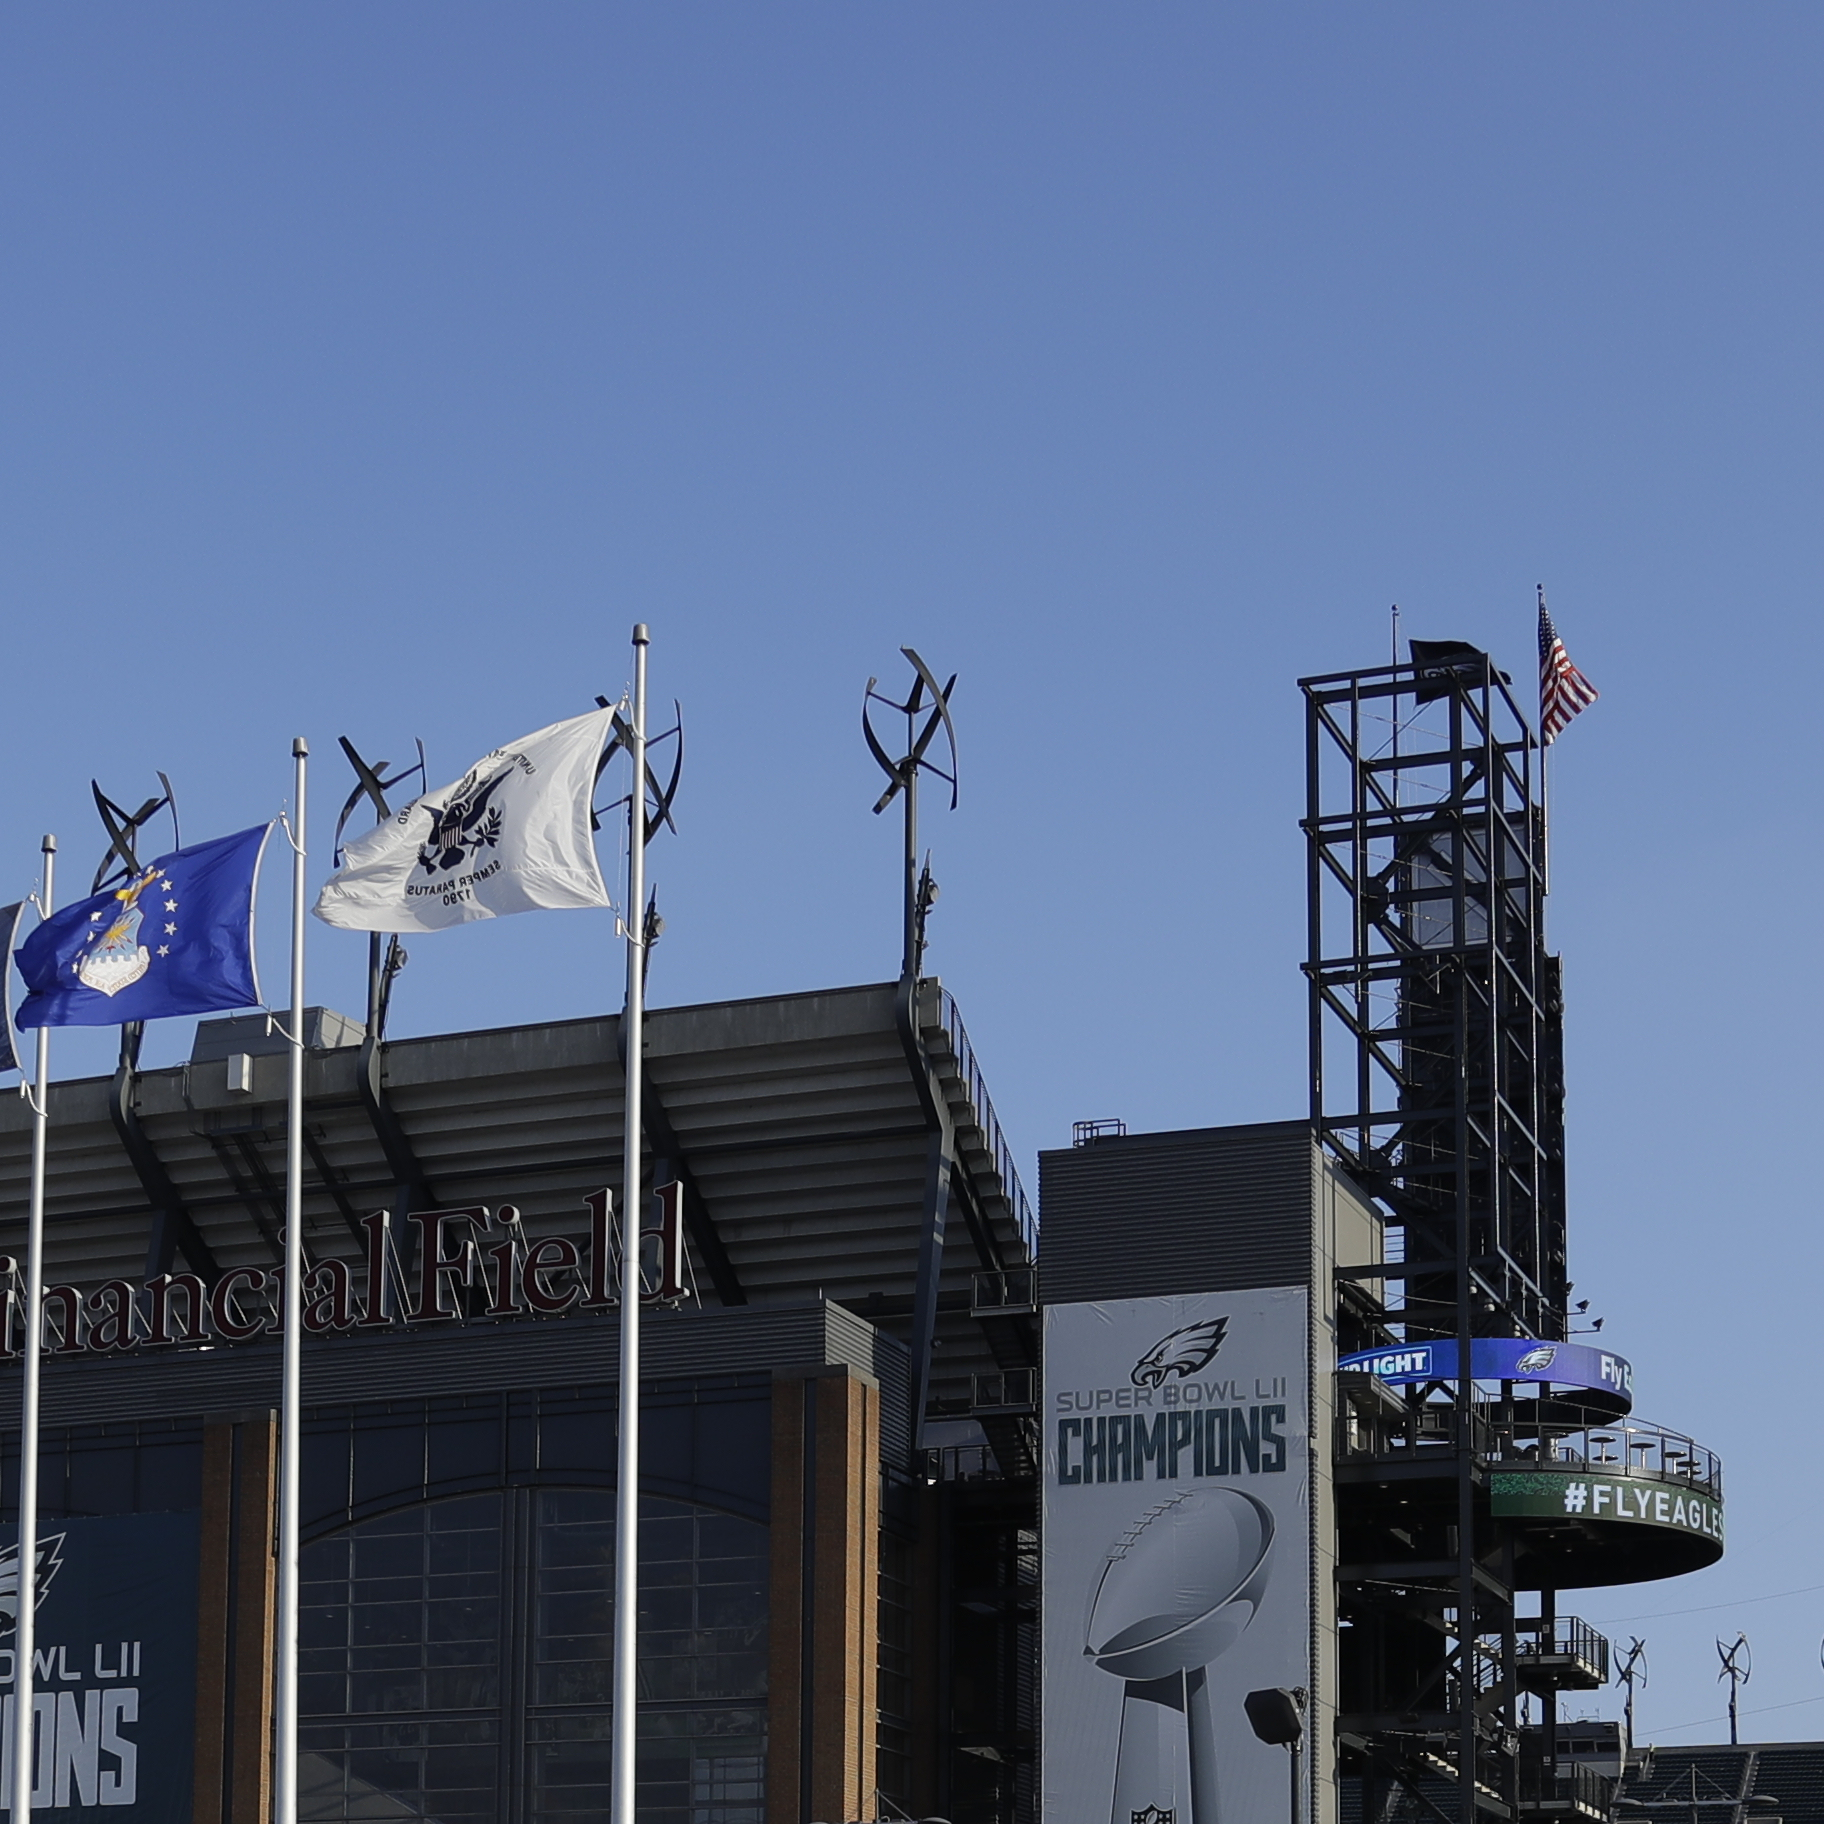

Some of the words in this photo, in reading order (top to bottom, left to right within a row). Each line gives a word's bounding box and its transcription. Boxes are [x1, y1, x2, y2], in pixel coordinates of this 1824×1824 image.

[407, 1180, 690, 1322] Field
[1600, 1354, 1623, 1391] Fly
[1056, 1388, 1154, 1413] SUPER
[1164, 1379, 1246, 1407] BOWL
[1253, 1377, 1288, 1400] LII
[1057, 1404, 1287, 1485] CHAMPIONS
[94, 1641, 141, 1678] LII
